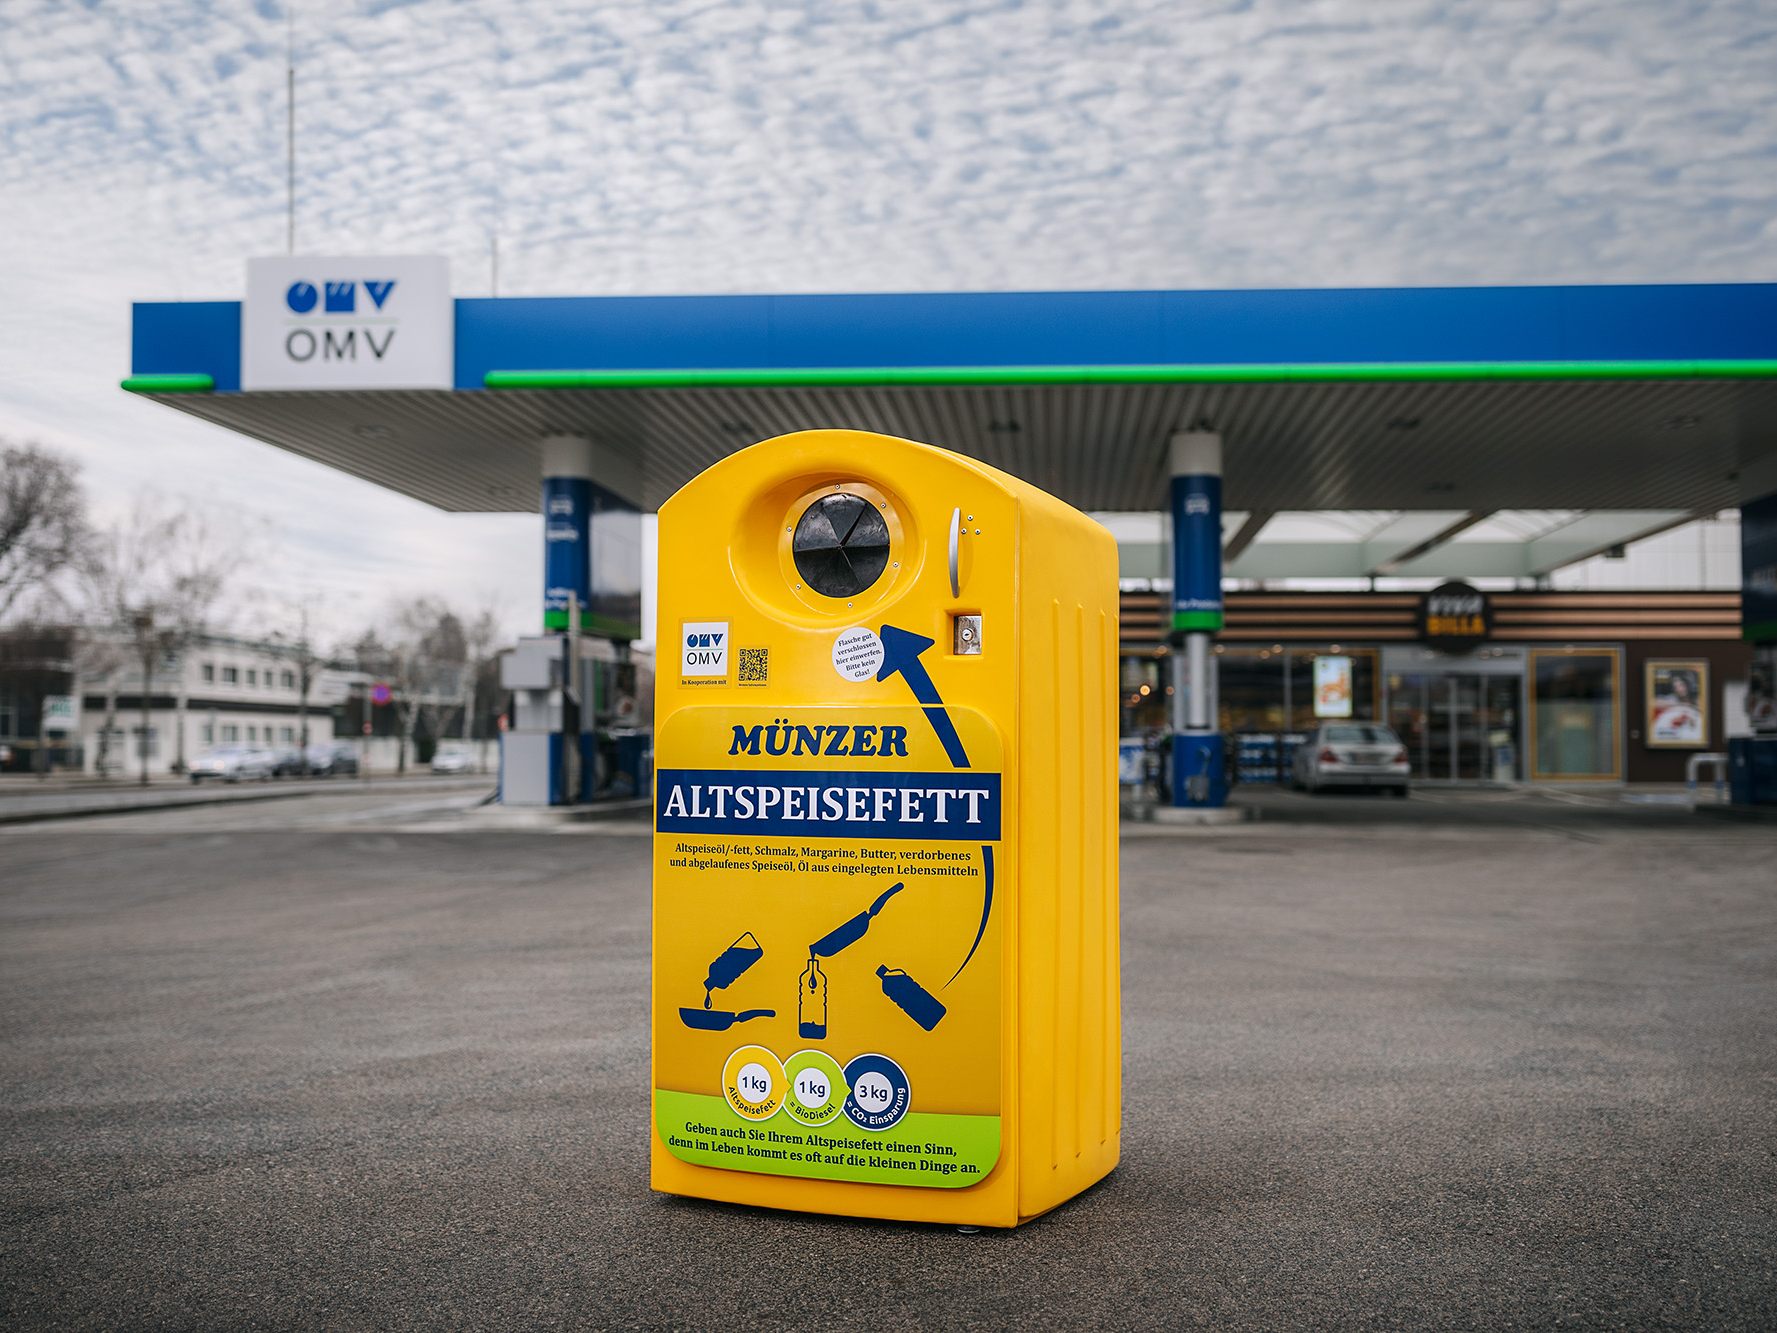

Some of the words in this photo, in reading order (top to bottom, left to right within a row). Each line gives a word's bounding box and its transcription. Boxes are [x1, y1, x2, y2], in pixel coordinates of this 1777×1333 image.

[286, 328, 395, 362] OMV
[837, 641, 876, 655] verschlossen
[838, 636, 860, 646] Flasche
[861, 633, 872, 641] gut
[686, 652, 722, 665] OMV
[836, 657, 848, 665] hier
[845, 663, 861, 671] Bitte
[861, 659, 875, 667] kein
[728, 718, 909, 757] MÜNZER
[663, 784, 989, 824] ALTSPEISEFETT
[675, 843, 753, 856] Altspeiseöl/-fett,
[755, 845, 799, 858] Schmalz,
[801, 847, 858, 860] Margarine,
[860, 848, 897, 861] Butter,
[899, 850, 971, 861] verdorbenes
[670, 858, 687, 867] und
[688, 858, 750, 870] abgelaufenes
[752, 860, 796, 873] Speiseöl,
[798, 860, 809, 872] Öl
[811, 863, 830, 873] aus
[832, 863, 894, 876] eingelegten
[897, 865, 979, 877] Lebensmitteln
[742, 1077, 748, 1089] 1
[751, 1076, 767, 1093] kg
[799, 1081, 806, 1094] 1
[809, 1081, 826, 1098] kg
[859, 1085, 868, 1098] 3
[871, 1085, 888, 1102] kg
[728, 1086, 776, 1115] Altspeisefett
[869, 1087, 906, 1125] Einsparung
[794, 1102, 836, 1120] BioDiesel
[685, 1121, 718, 1136] Geben
[719, 1127, 746, 1139] auch
[748, 1129, 766, 1141] Sie
[768, 1131, 803, 1145] Ihrem
[805, 1134, 883, 1150] Altspeisefett
[886, 1141, 922, 1154] einen
[924, 1143, 957, 1157] Sinn,
[668, 1135, 693, 1149] denn
[695, 1139, 709, 1151] im
[711, 1141, 745, 1155] Leben
[746, 1144, 788, 1160] kommt
[789, 1151, 803, 1161] es
[805, 1151, 823, 1163] oft
[824, 1154, 845, 1165] auf
[846, 1154, 866, 1167] die
[868, 1156, 917, 1171] kleinen
[919, 1159, 958, 1175] Dinge
[960, 1164, 981, 1174] an.
